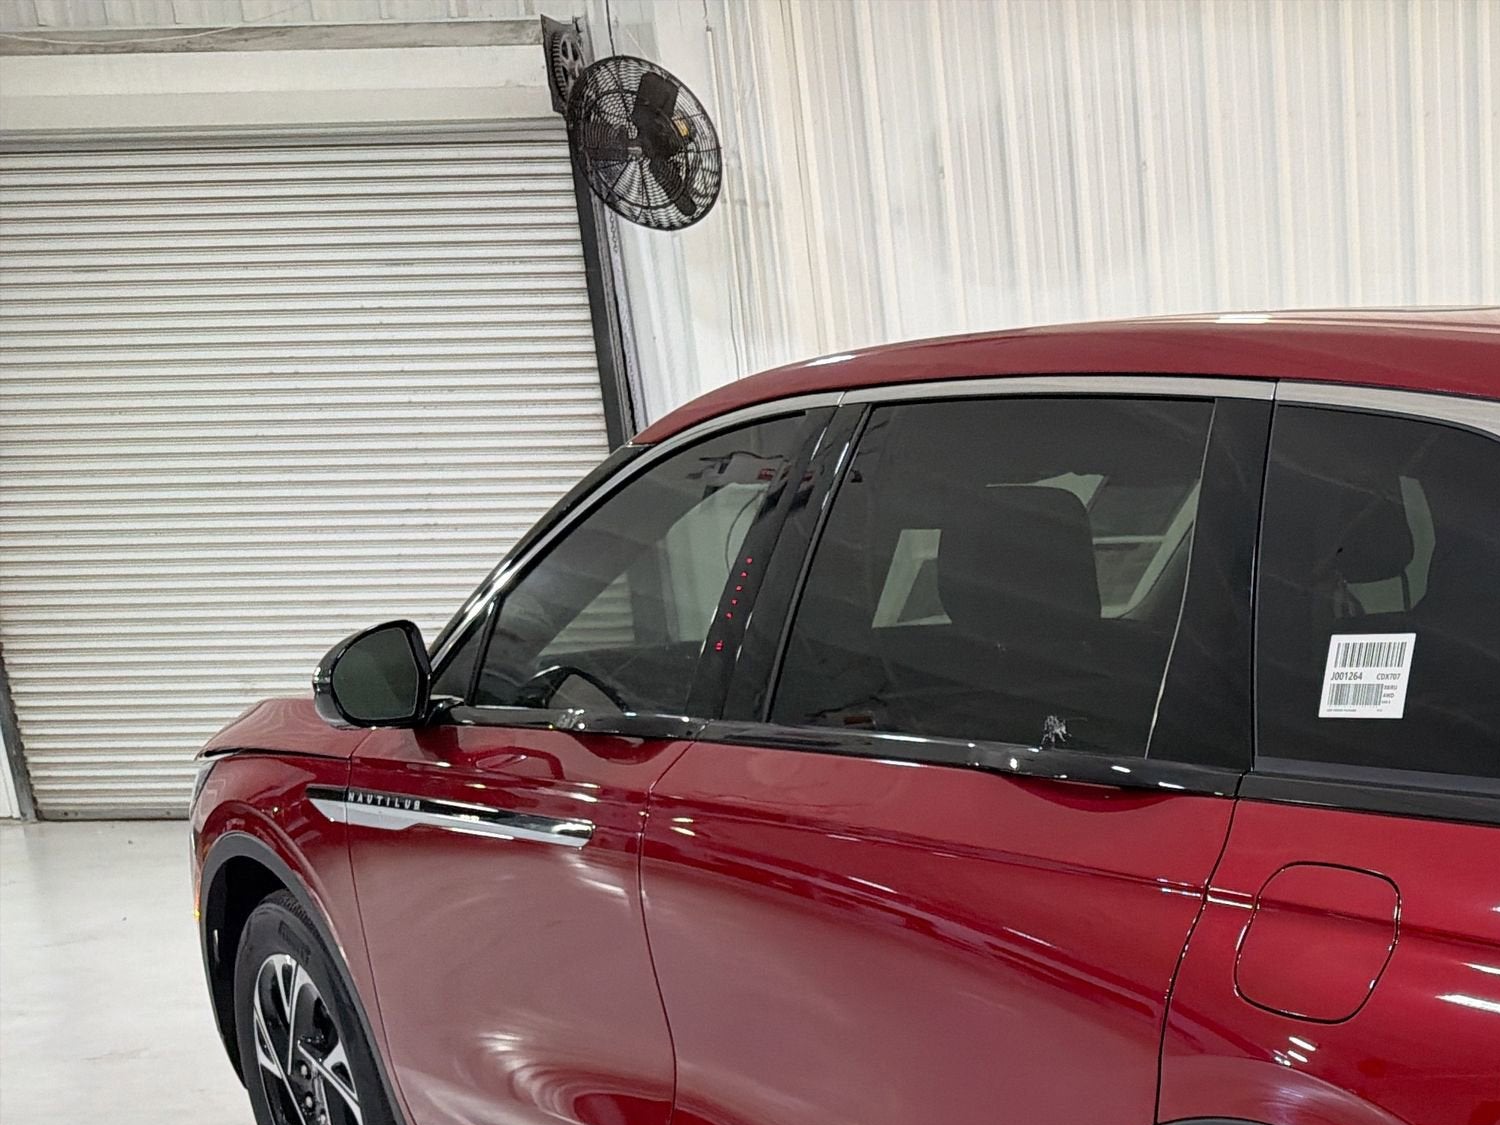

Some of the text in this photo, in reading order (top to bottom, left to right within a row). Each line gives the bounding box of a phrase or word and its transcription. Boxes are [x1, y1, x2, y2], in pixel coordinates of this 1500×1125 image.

[1330, 671, 1401, 681] J001264 CDX707
[348, 791, 421, 811] NAUTILUS
